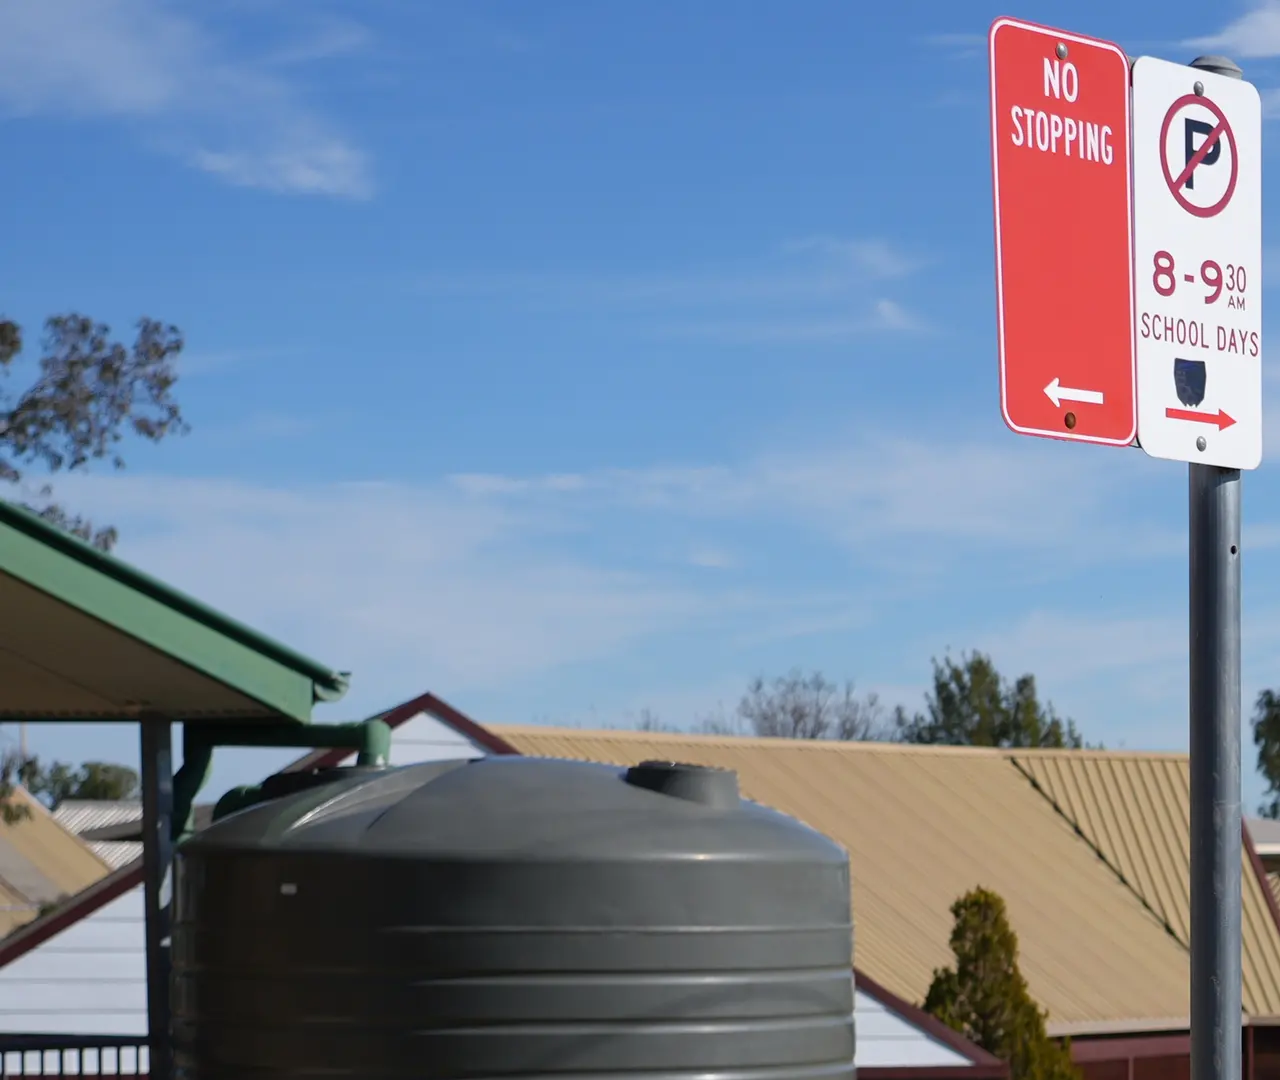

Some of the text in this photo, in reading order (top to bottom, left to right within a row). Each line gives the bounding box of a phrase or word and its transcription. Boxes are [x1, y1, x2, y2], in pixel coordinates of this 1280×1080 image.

[1042, 56, 1079, 103] NO
[1011, 104, 1114, 165] STOPPING
[1227, 295, 1246, 311] AM
[1140, 312, 1259, 357] SCHOOL DAYS
